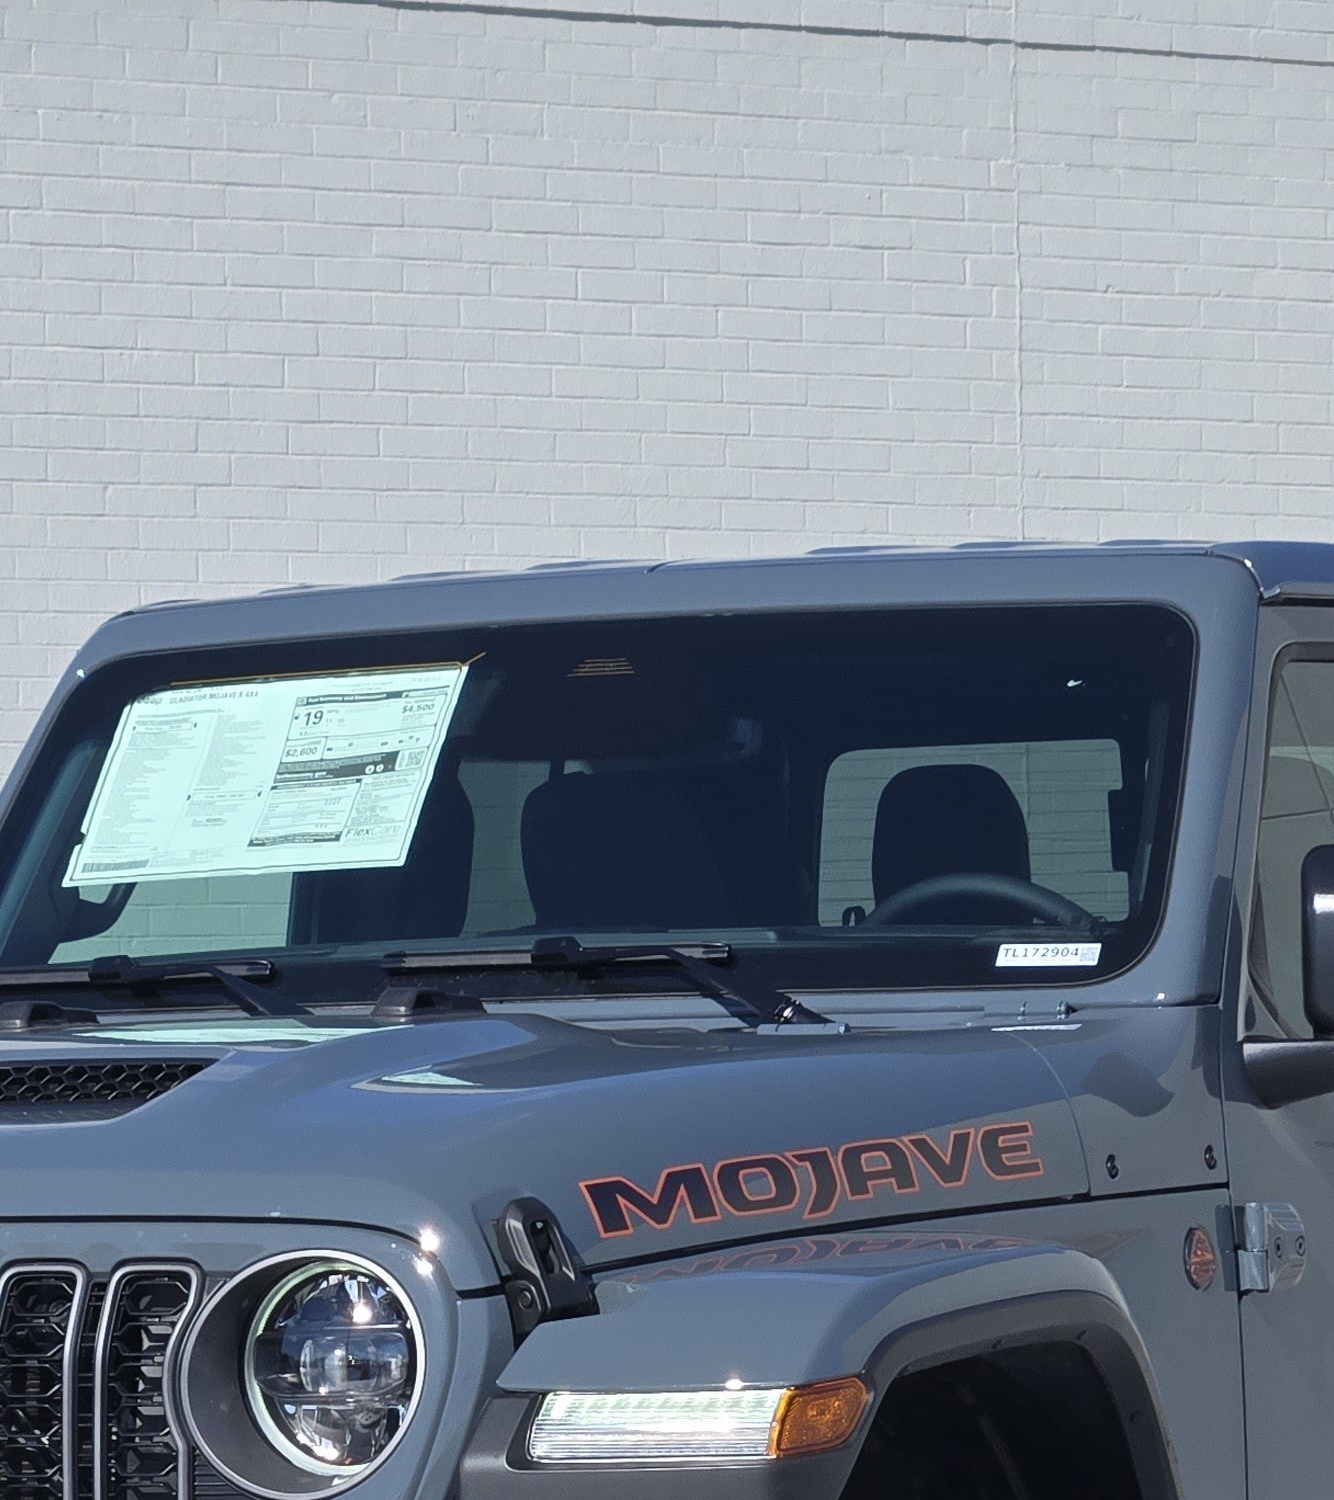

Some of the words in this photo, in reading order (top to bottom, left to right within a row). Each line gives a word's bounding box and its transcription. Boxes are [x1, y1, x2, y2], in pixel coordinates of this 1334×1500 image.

[303, 709, 325, 727] 19
[1003, 947, 1079, 958] TL172904
[578, 1121, 1044, 1239] MOJAVE
